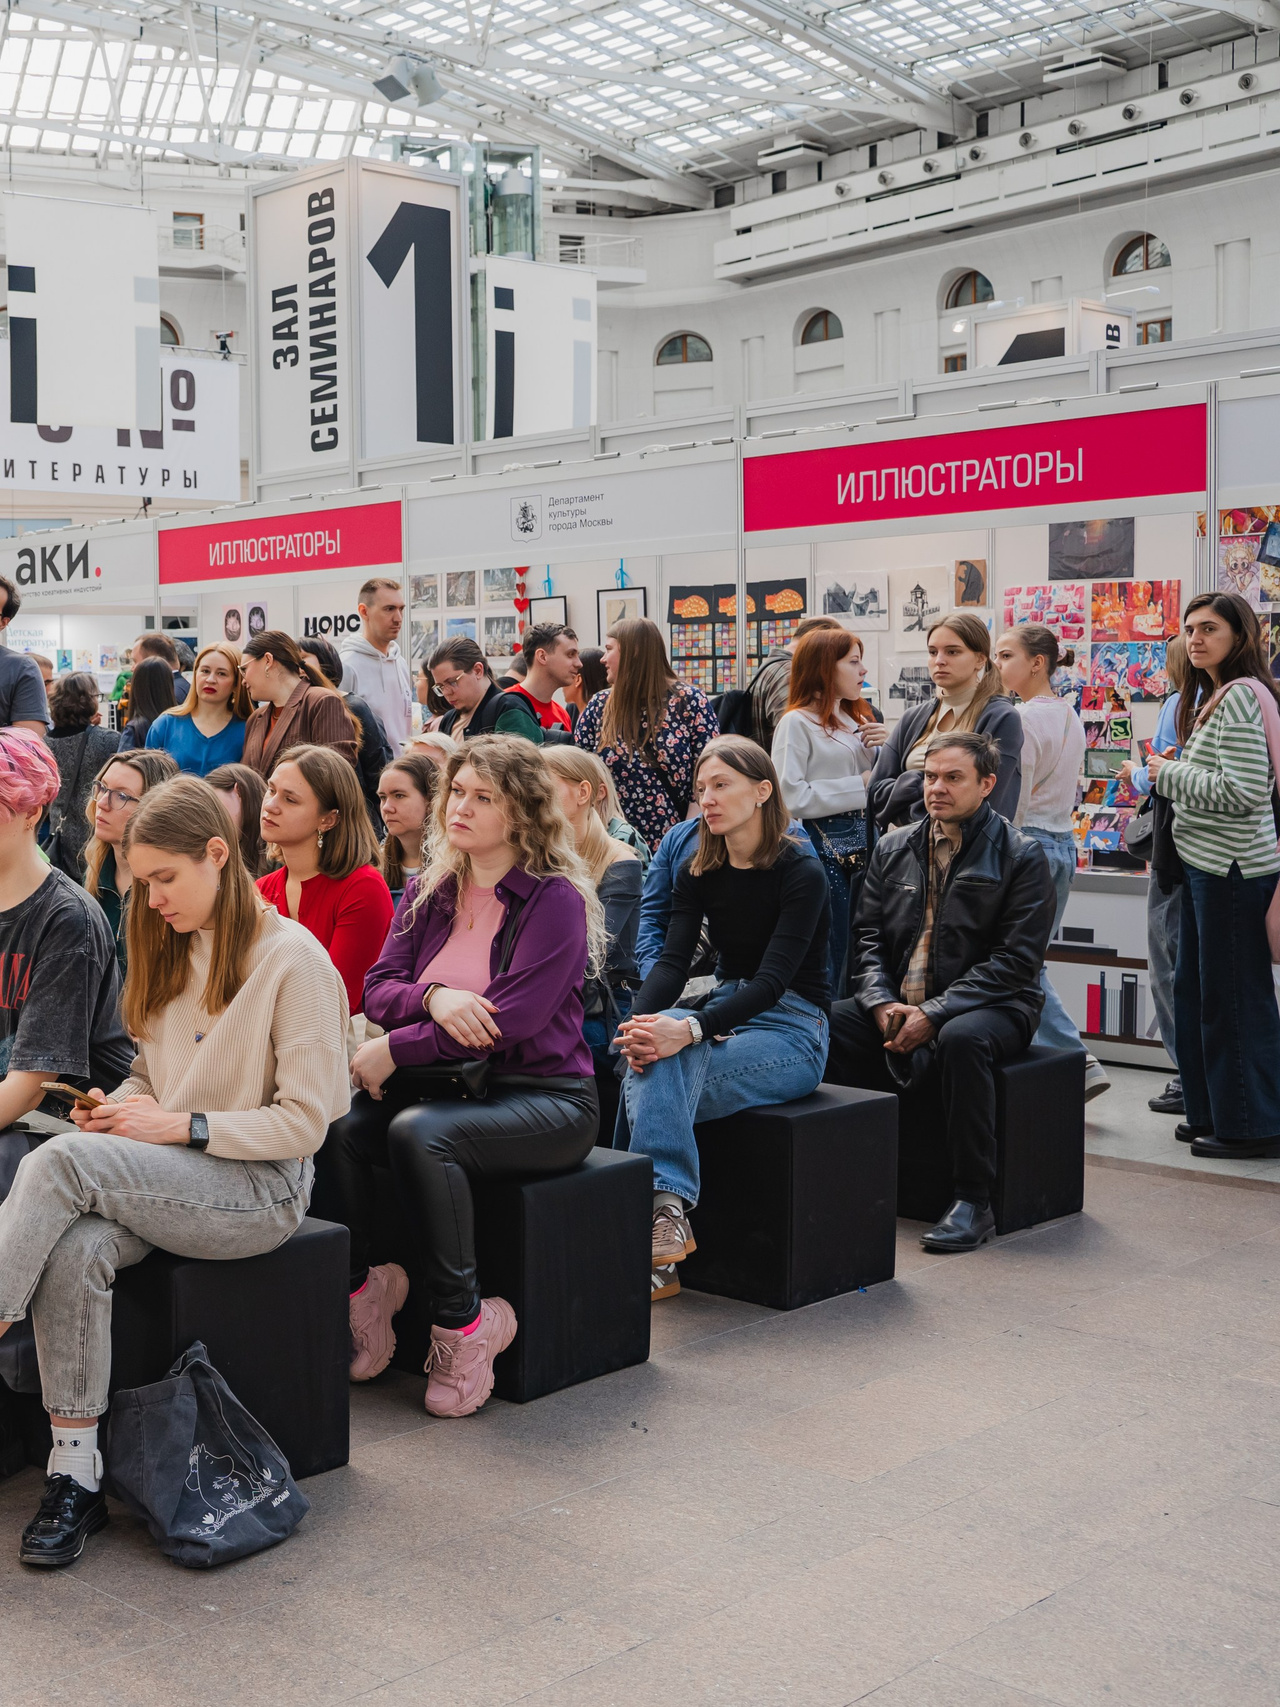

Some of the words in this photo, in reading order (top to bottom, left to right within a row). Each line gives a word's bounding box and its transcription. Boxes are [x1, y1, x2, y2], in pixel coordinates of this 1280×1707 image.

[271, 284, 299, 370] ЗАЛ
[307, 187, 339, 453] СЕМИНАРОВ
[366, 201, 455, 445] 1
[836, 447, 1084, 505] ИЛЛЮСТРАТОРЫ
[548, 493, 605, 508] Департамент
[548, 508, 587, 521] культуры
[208, 528, 341, 567] ИЛЛЮСТРАТОРЫ
[548, 522, 578, 533] города
[579, 518, 614, 529] Москвы
